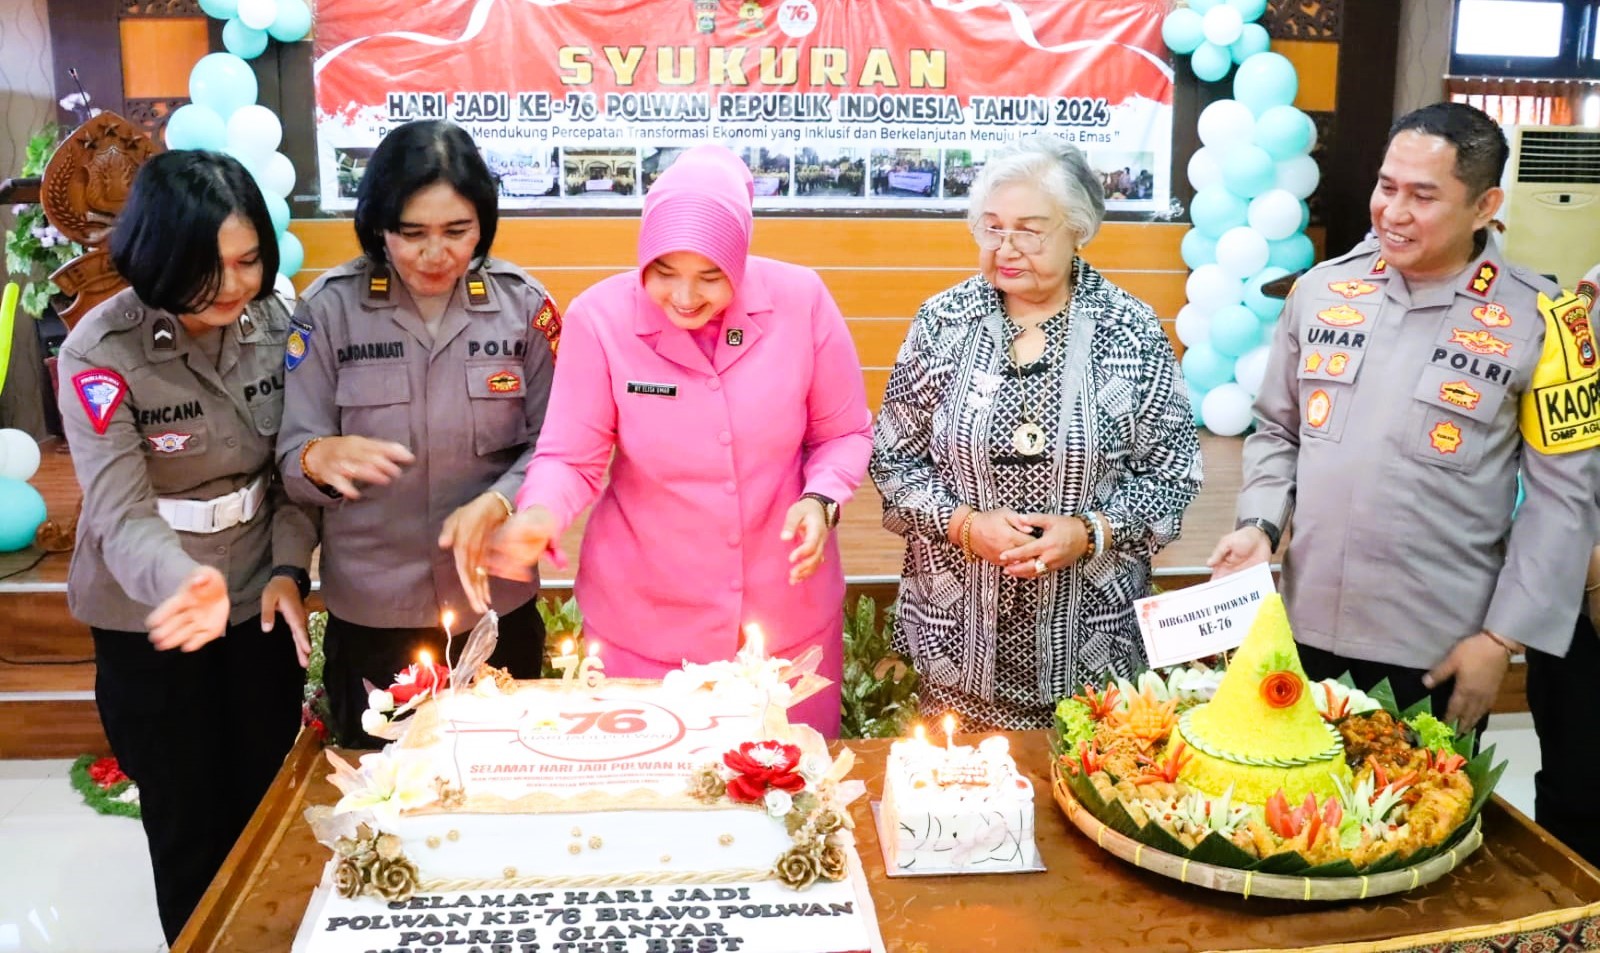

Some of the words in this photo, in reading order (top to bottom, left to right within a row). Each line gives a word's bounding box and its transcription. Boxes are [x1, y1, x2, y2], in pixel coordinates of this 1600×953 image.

[786, 5, 809, 21] 76
[558, 46, 947, 89] SYUKURAN
[387, 93, 446, 119] HARI
[453, 93, 508, 120] JADI
[605, 93, 709, 120] POLWAN
[718, 94, 831, 121] REPUBLIK
[839, 95, 964, 122] INDONESIA
[970, 98, 1048, 124] TAHUN
[1054, 99, 1109, 125] 2024
[472, 126, 548, 140] Mendukung
[552, 126, 623, 140] Percepatan
[628, 125, 709, 139] Transformasi
[712, 125, 768, 139] Ekonomi
[770, 127, 800, 141] yang
[805, 126, 850, 139] Inklusif
[853, 127, 877, 139] dan
[880, 127, 966, 143] Berkelanjutan
[970, 129, 1014, 143] Menuju
[1079, 131, 1112, 142] Emas
[1308, 328, 1366, 348] UMAR
[1431, 348, 1512, 386] POLRI
[243, 375, 284, 401] POL
[135, 400, 204, 425] ENCANA
[1545, 381, 1600, 426] KAOP
[1158, 607, 1212, 629] DIRGAHAYU
[1250, 590, 1260, 602] RI
[1199, 616, 1232, 637] KE-76
[560, 708, 647, 735] 76
[470, 764, 535, 774] SELAMAT
[539, 763, 574, 773] HARI
[577, 763, 608, 772] JADI
[611, 761, 674, 771] POLWAN
[564, 889, 653, 905] HARI
[668, 887, 750, 902] JADI
[325, 912, 472, 932] POLWAN
[480, 908, 582, 926] KE-76
[595, 905, 710, 922] BRAVO
[719, 901, 854, 919] POLWAN
[398, 928, 537, 946] POLRES
[646, 937, 744, 953] BEST
